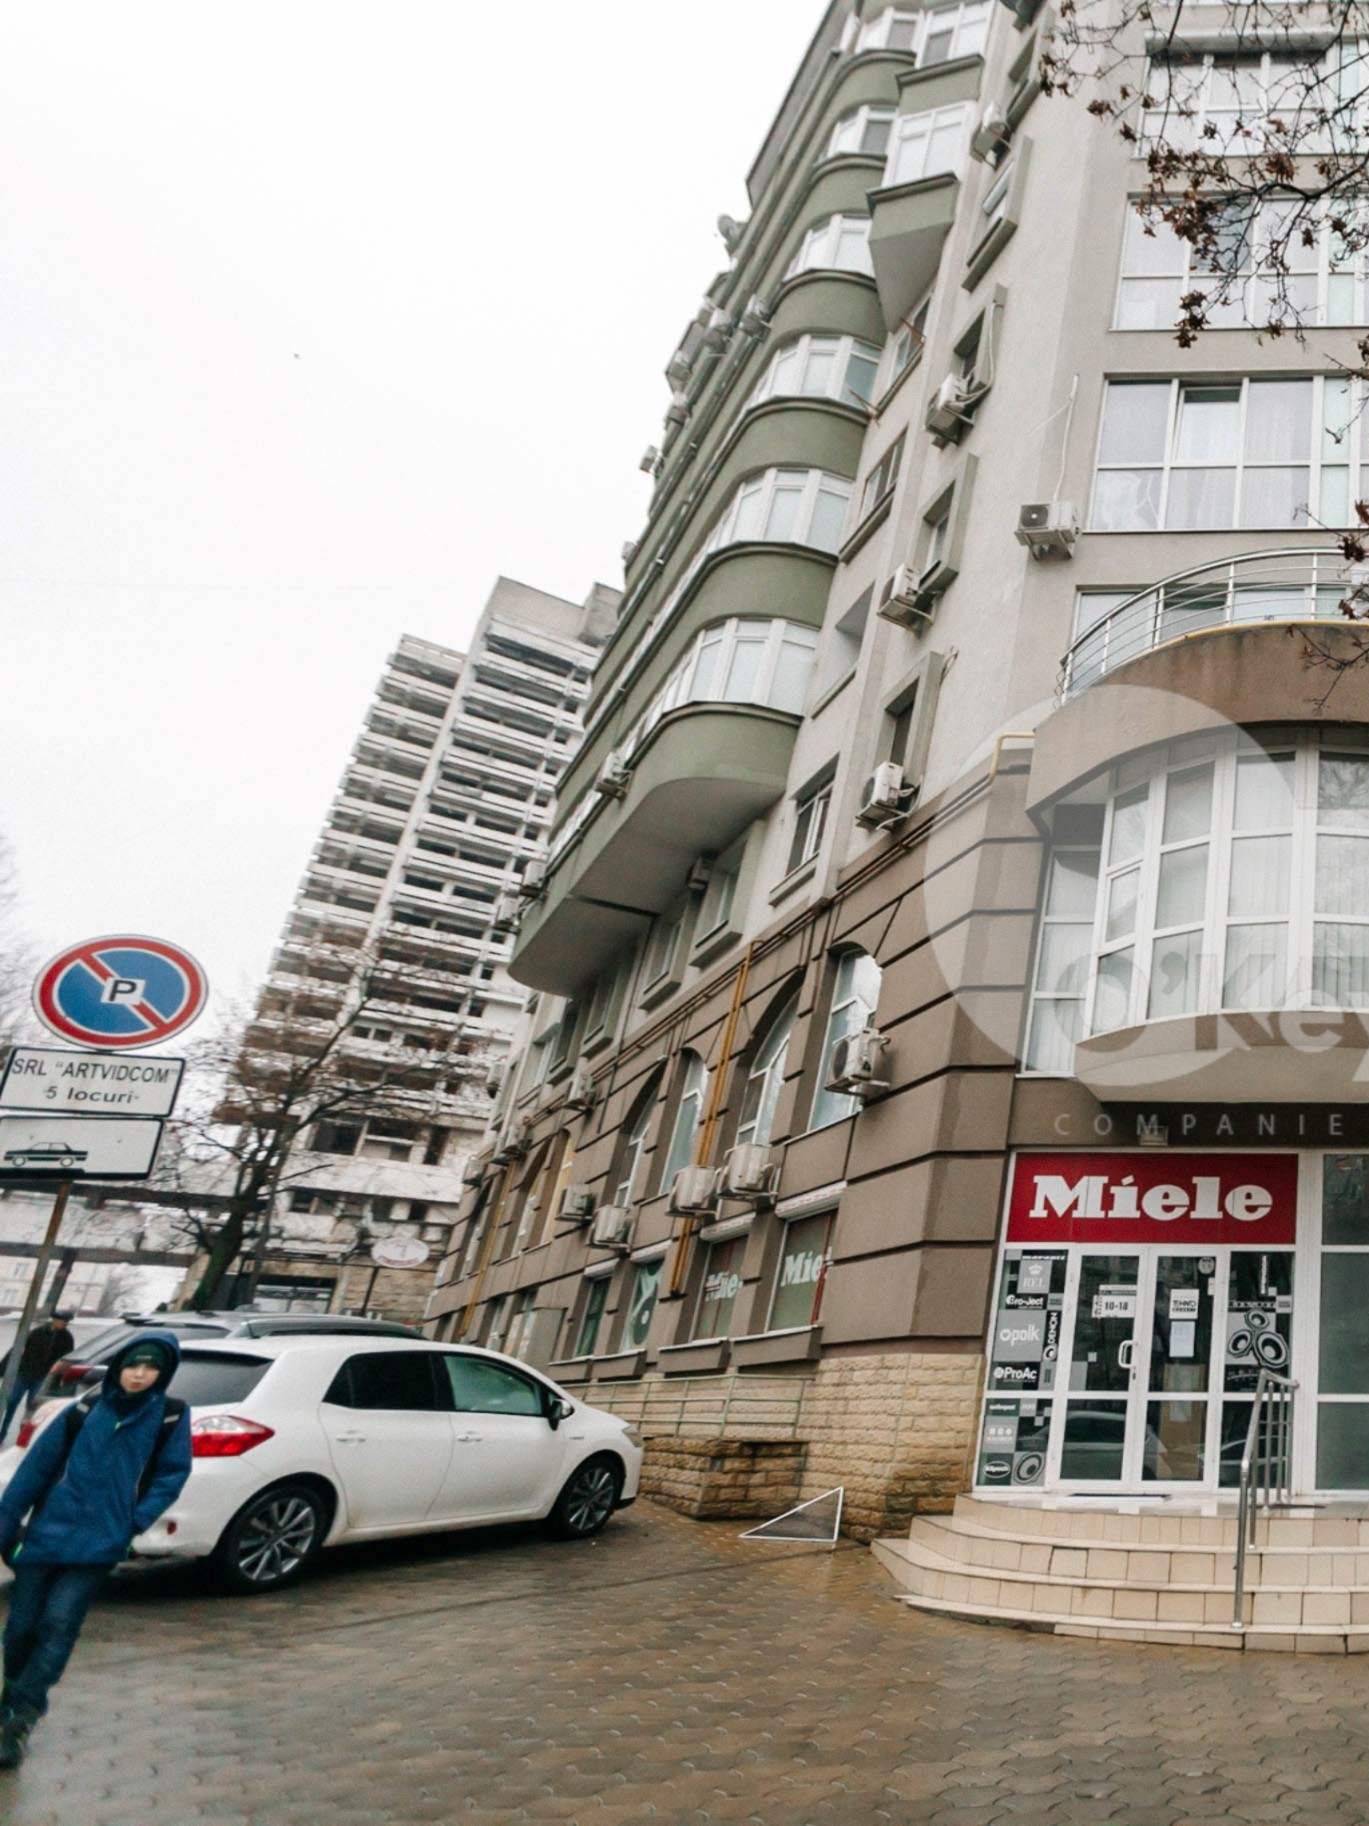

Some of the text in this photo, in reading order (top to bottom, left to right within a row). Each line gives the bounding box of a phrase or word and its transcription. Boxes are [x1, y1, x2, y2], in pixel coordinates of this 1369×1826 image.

[109, 979, 137, 1002] P
[12, 1058, 47, 1076] SRL
[1029, 1175, 1273, 1221] Miele
[1105, 1301, 1128, 1311] 10-18
[1047, 1312, 1059, 1344] DENON
[1004, 1366, 1037, 1380] ProAc
